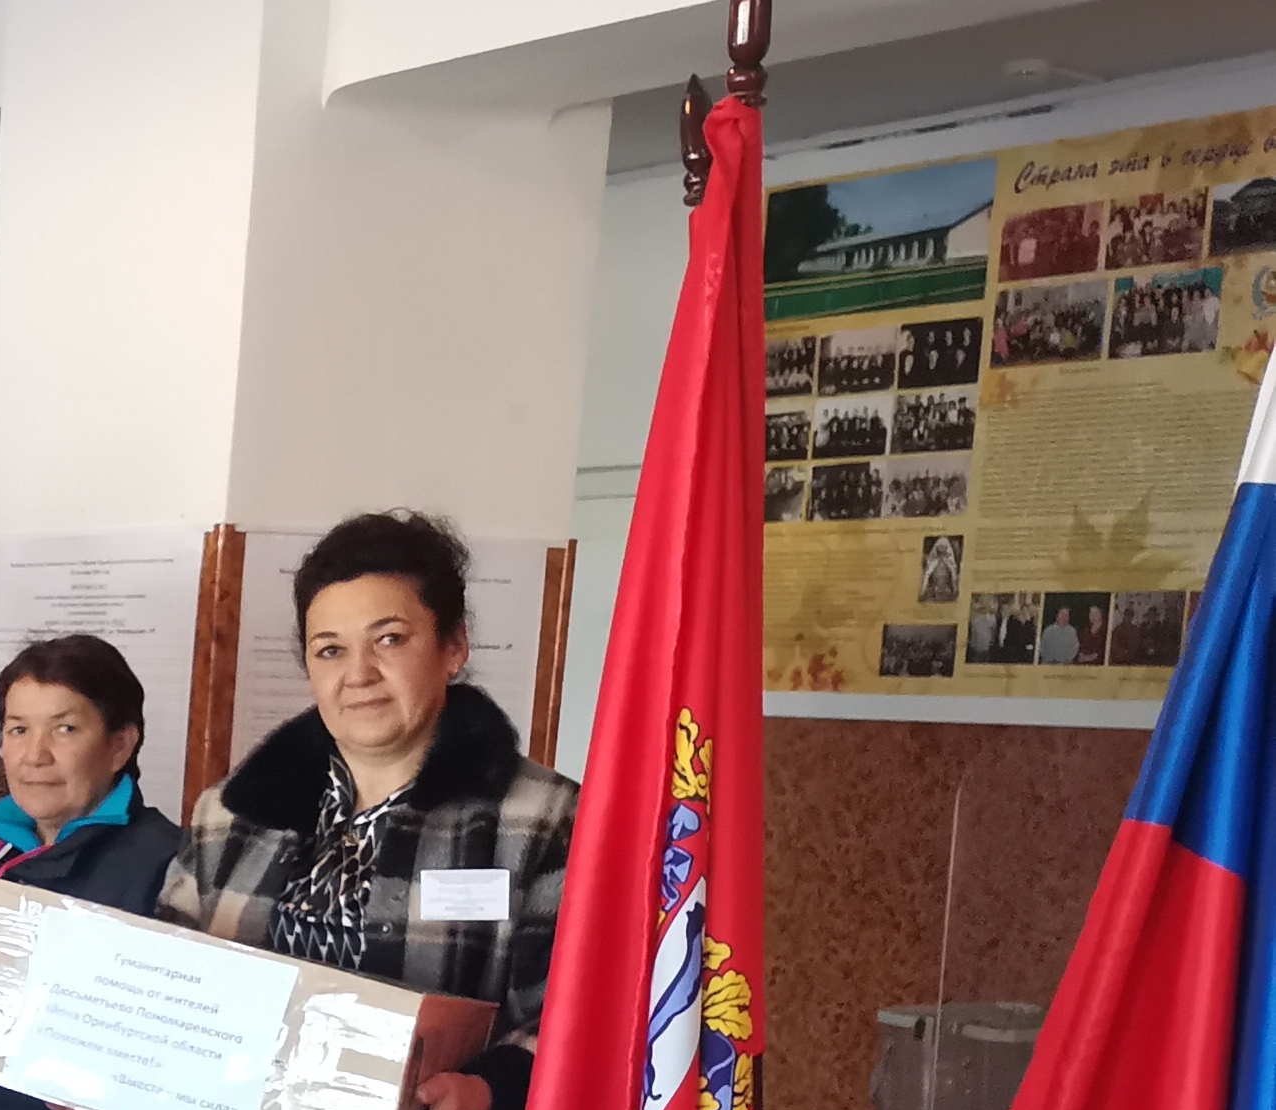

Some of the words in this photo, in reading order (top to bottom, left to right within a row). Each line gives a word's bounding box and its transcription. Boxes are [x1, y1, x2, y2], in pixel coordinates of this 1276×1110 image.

[115, 953, 201, 984] Гуманитарная
[94, 975, 144, 996] помощь
[147, 989, 161, 998] от
[164, 995, 220, 1014] жителей
[171, 1040, 222, 1060] области
